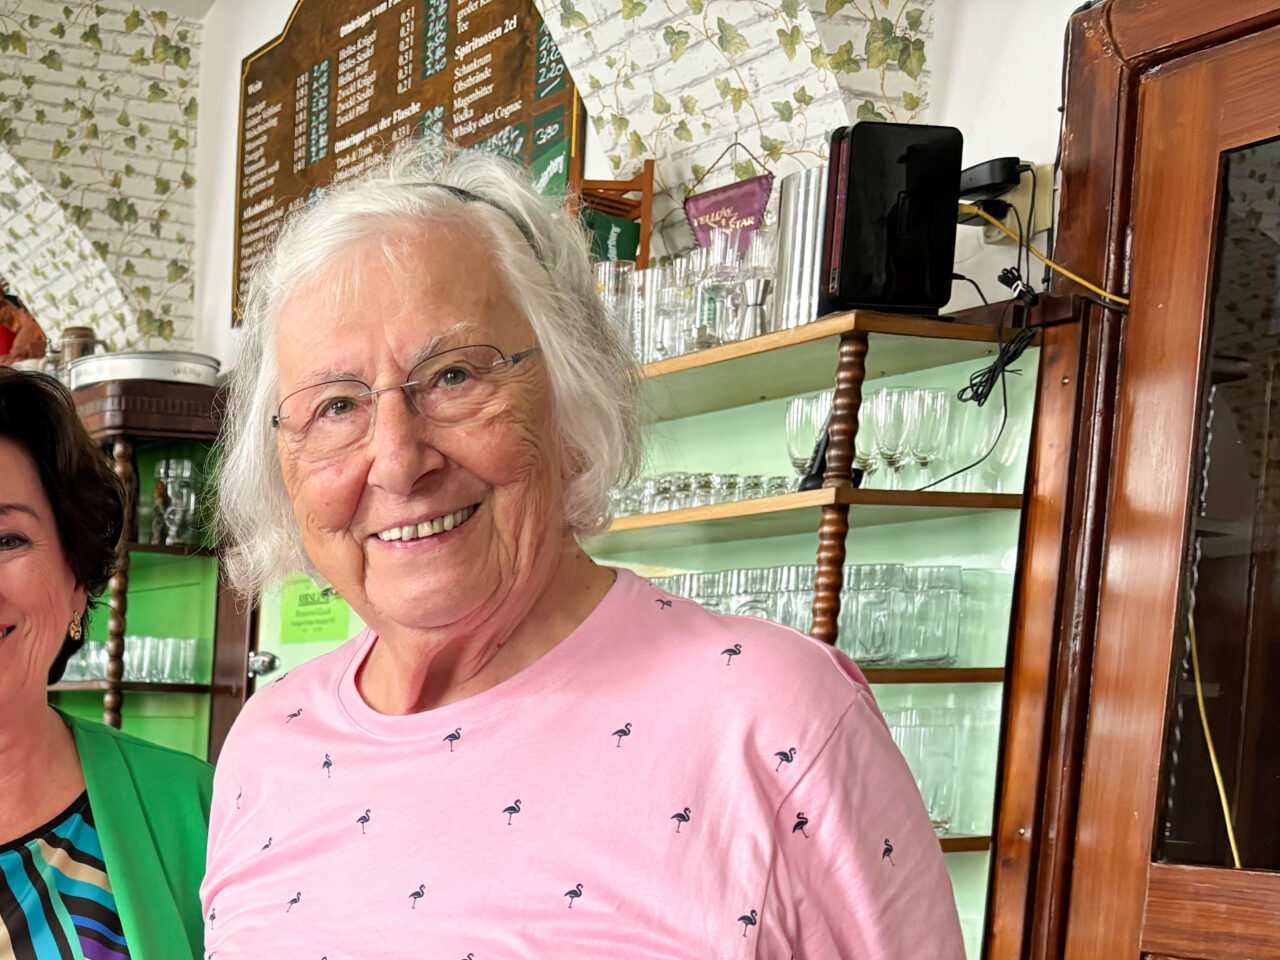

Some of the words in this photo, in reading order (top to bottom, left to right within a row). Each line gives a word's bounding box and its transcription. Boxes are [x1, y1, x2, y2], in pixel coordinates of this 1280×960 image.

[454, 26, 502, 61] Spirituosen
[392, 102, 421, 124] Flasche
[452, 120, 477, 139] Whisky
[478, 112, 494, 127] oder
[494, 100, 522, 118] Cognac
[694, 206, 734, 227] YELLOW
